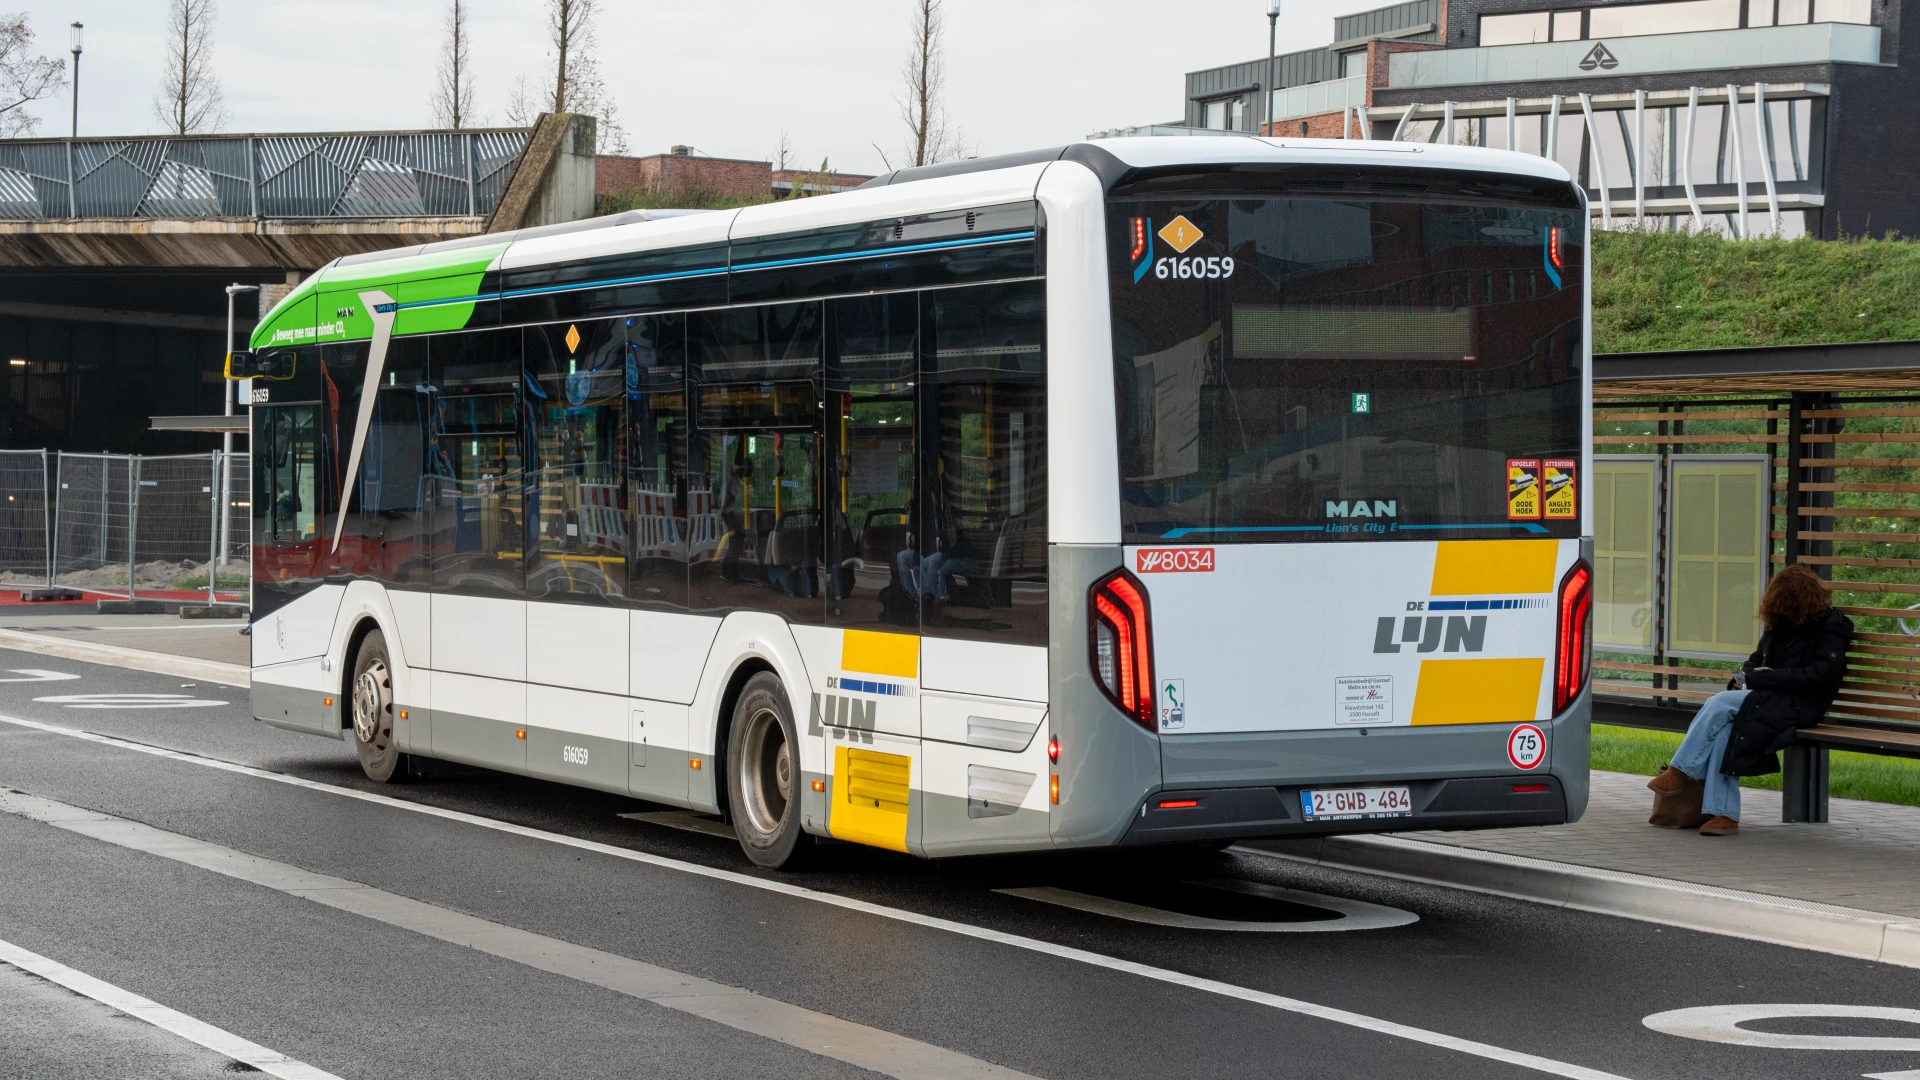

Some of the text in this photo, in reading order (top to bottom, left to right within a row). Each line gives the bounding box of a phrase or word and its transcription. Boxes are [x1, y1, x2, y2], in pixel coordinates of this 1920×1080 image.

[1155, 256, 1235, 279] 616059
[336, 306, 355, 318] MAN
[276, 327, 294, 343] Beweeg
[294, 327, 304, 339] mee
[304, 326, 316, 337] naar
[316, 322, 335, 336] minder
[1326, 500, 1397, 518] MAN
[1325, 522, 1397, 534] Lion's City E
[1406, 601, 1425, 611] DE
[1373, 615, 1488, 653] LIJN
[826, 676, 839, 689] DE
[807, 692, 877, 745] LIJN
[1517, 734, 1537, 751] 75
[563, 745, 589, 765] 616059
[1520, 752, 1534, 761] km
[1305, 805, 1313, 814] B
